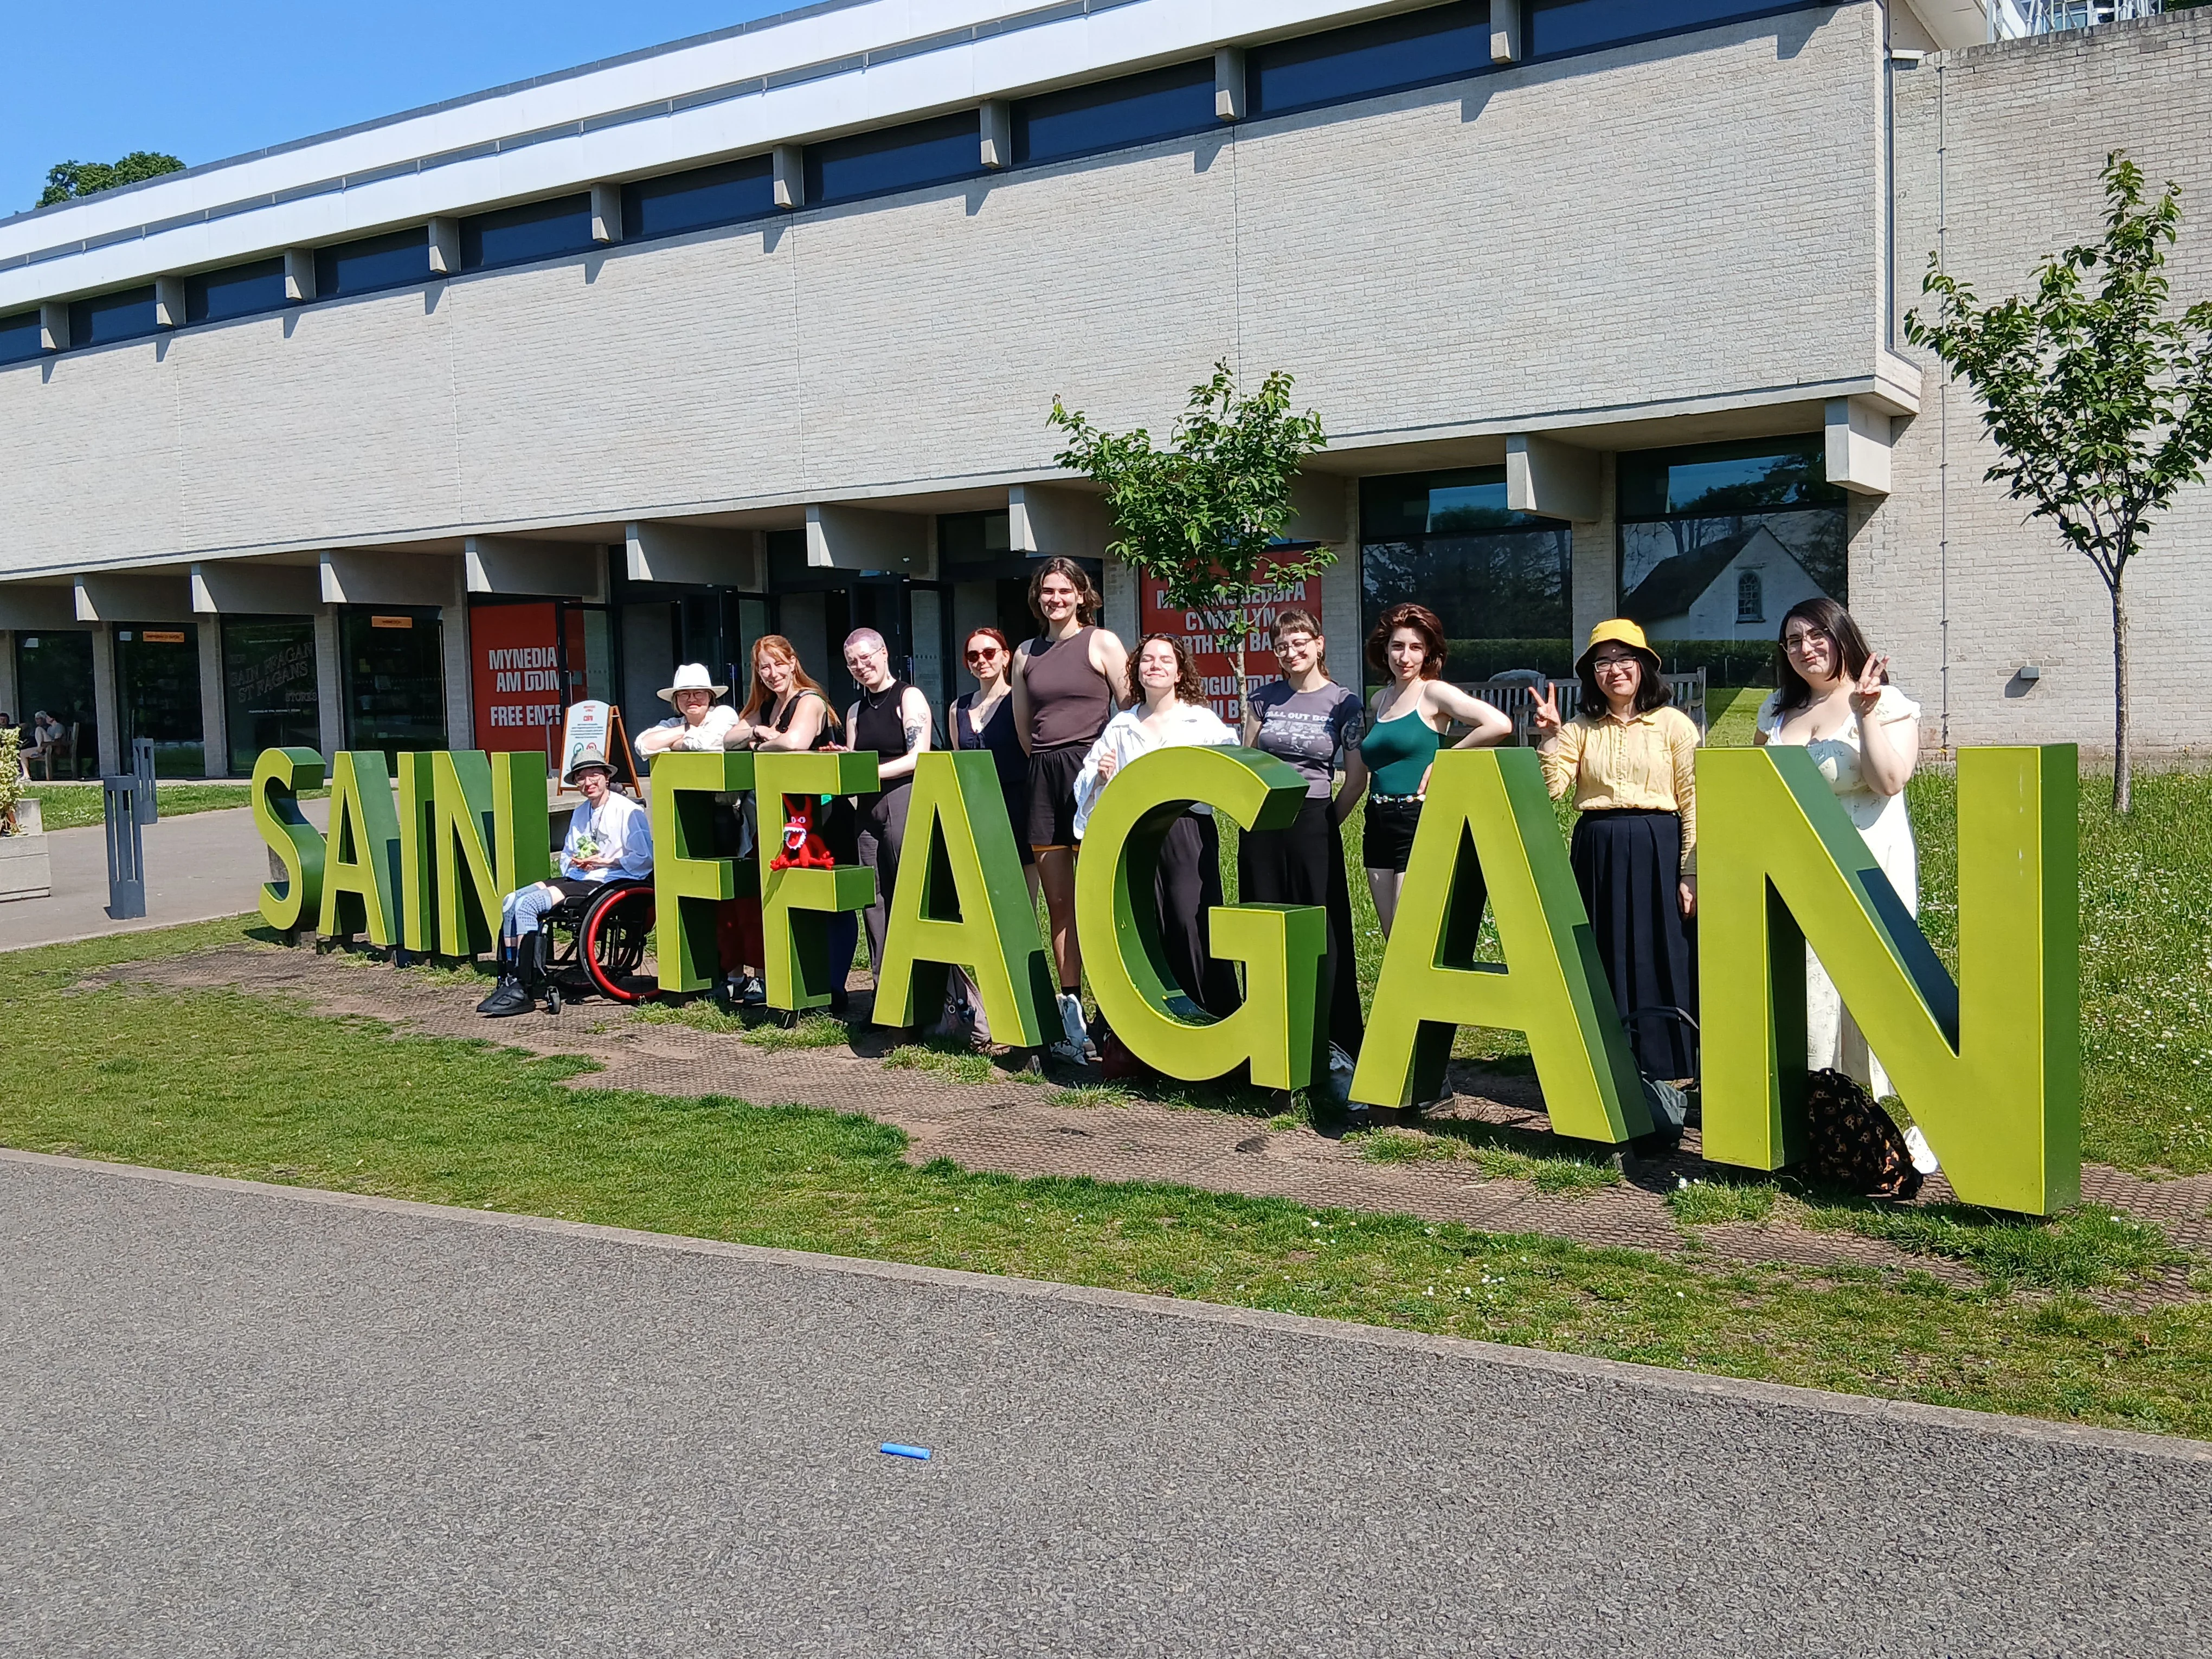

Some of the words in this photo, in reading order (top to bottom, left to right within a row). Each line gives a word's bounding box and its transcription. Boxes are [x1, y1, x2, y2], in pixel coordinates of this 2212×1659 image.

[488, 647, 558, 670] MYNEDIA
[496, 672, 522, 692] AM
[491, 706, 524, 726] FREE
[252, 747, 549, 957] SAIN
[648, 743, 2078, 1214] FFAGAN
